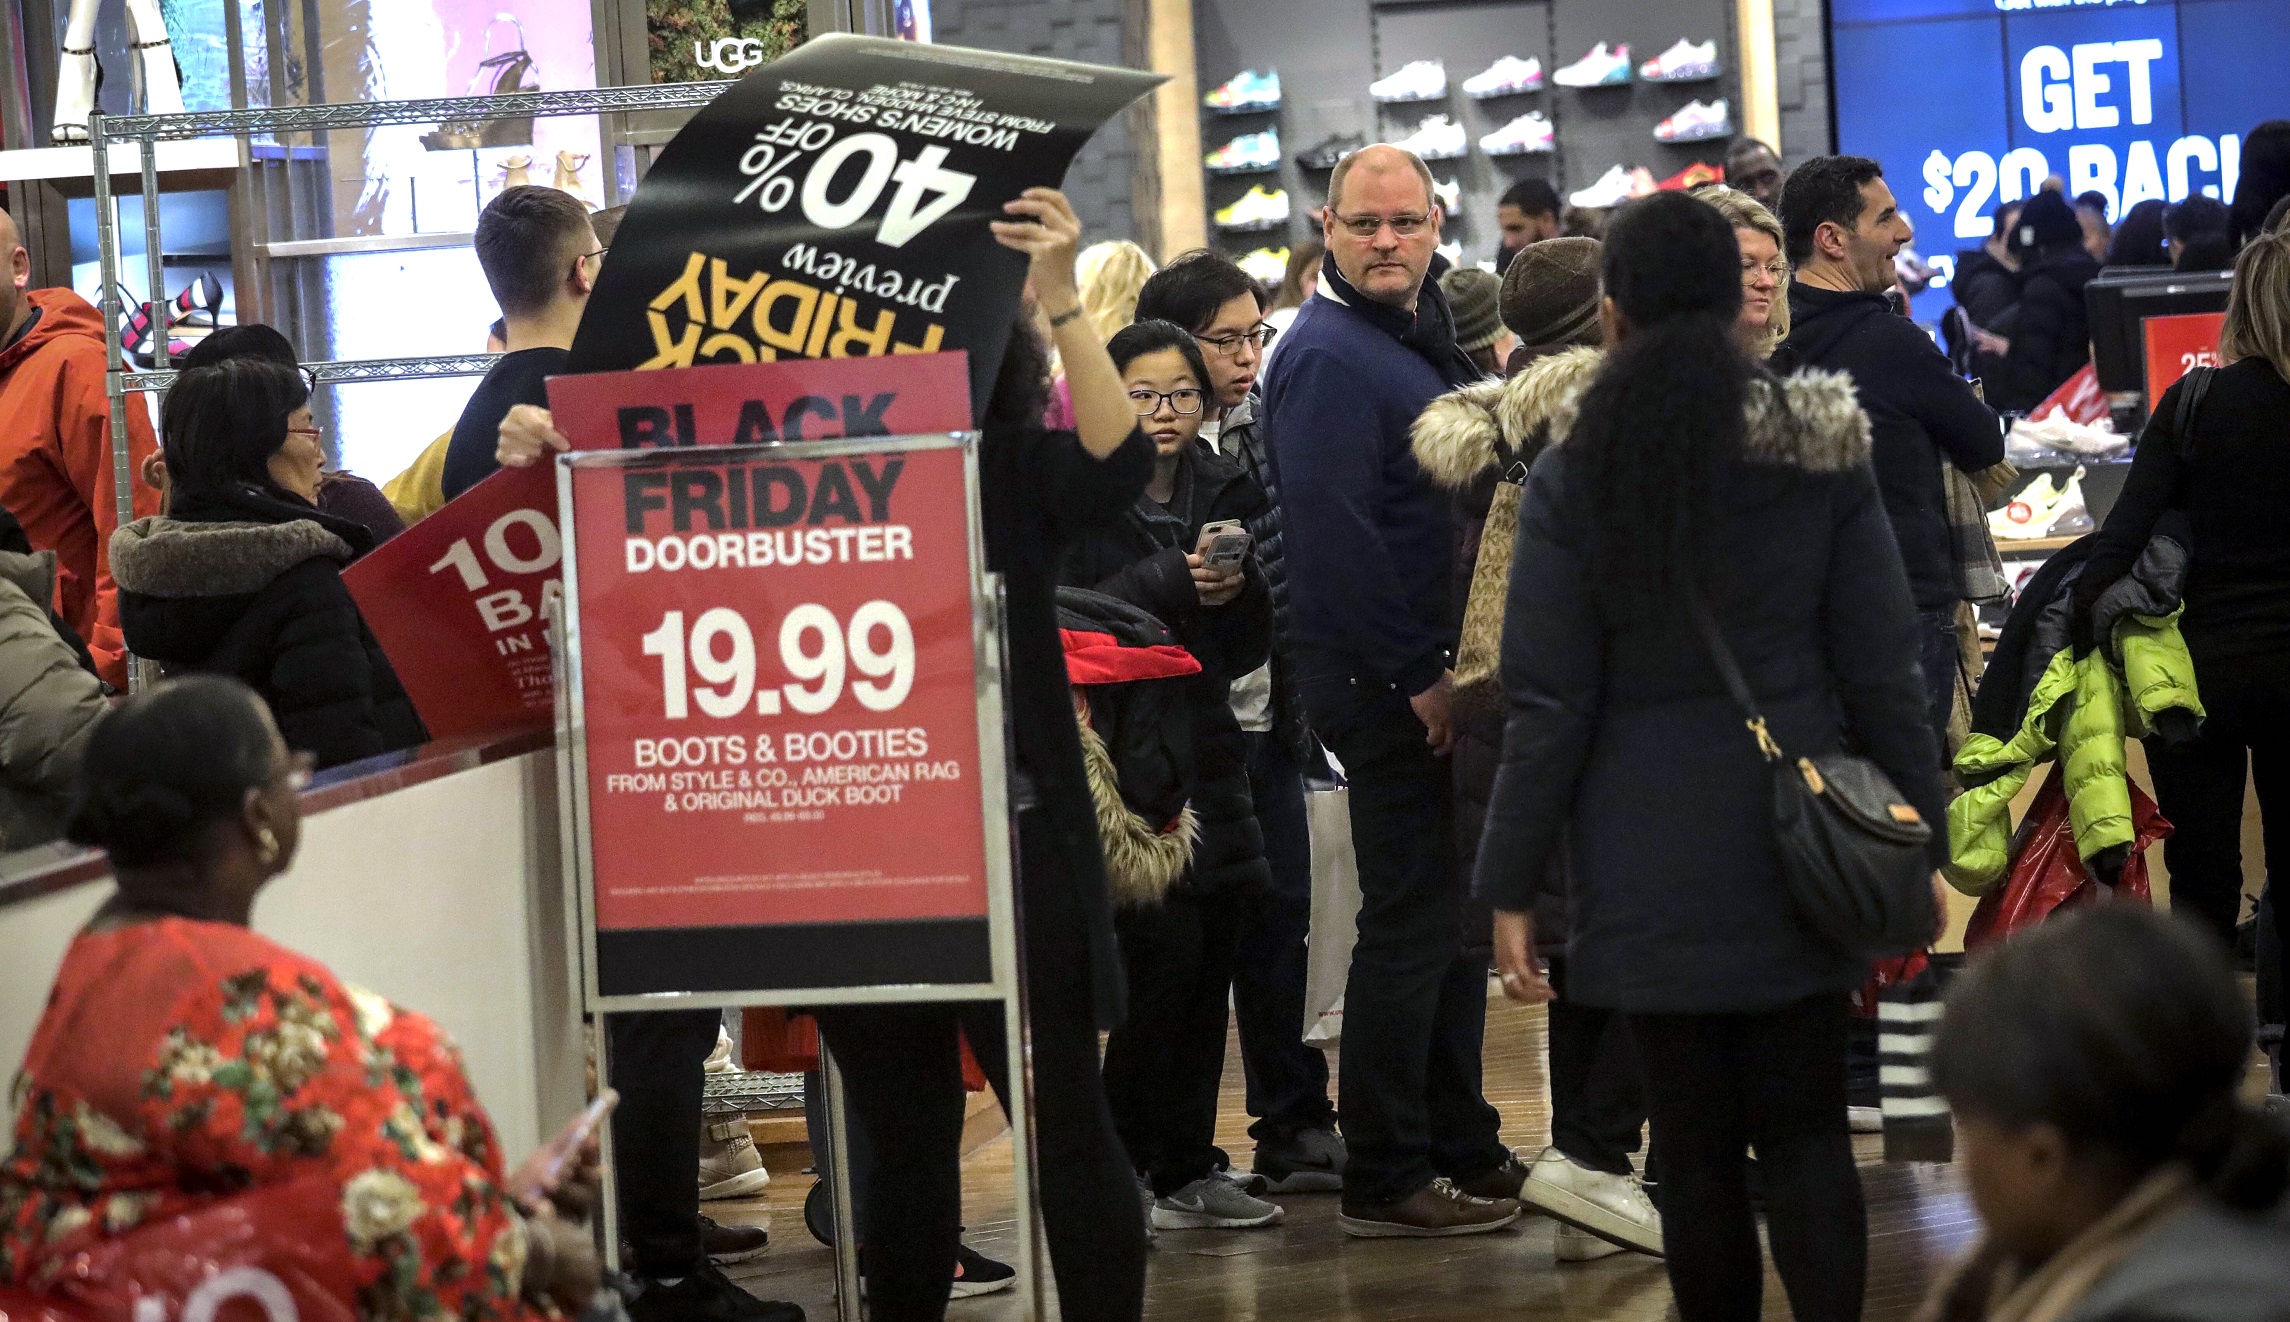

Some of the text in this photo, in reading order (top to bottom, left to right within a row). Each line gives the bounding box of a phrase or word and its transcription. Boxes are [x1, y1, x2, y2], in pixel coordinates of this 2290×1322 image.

[695, 36, 763, 73] UGG
[870, 84, 925, 101] MORE
[2020, 39, 2162, 133] GET
[774, 93, 1020, 151] WOMEN'S SHOES
[937, 104, 999, 124] STEVE
[997, 114, 1057, 134] FROM
[755, 117, 834, 150] OFF
[781, 242, 961, 313] preview
[624, 460, 905, 533] FRIDAY
[625, 525, 914, 573] DOORBUSTER
[496, 633, 533, 656] IN
[642, 600, 916, 719] 19.99
[634, 727, 929, 768] BOOTS & BOOTIES
[607, 773, 666, 793] FROM
[671, 770, 734, 791] STYLE
[738, 769, 752, 788] &
[802, 763, 910, 785] AMERICAN
[914, 760, 961, 781] RAG
[664, 784, 904, 812] & ORIGINAL DUCK BOOT
